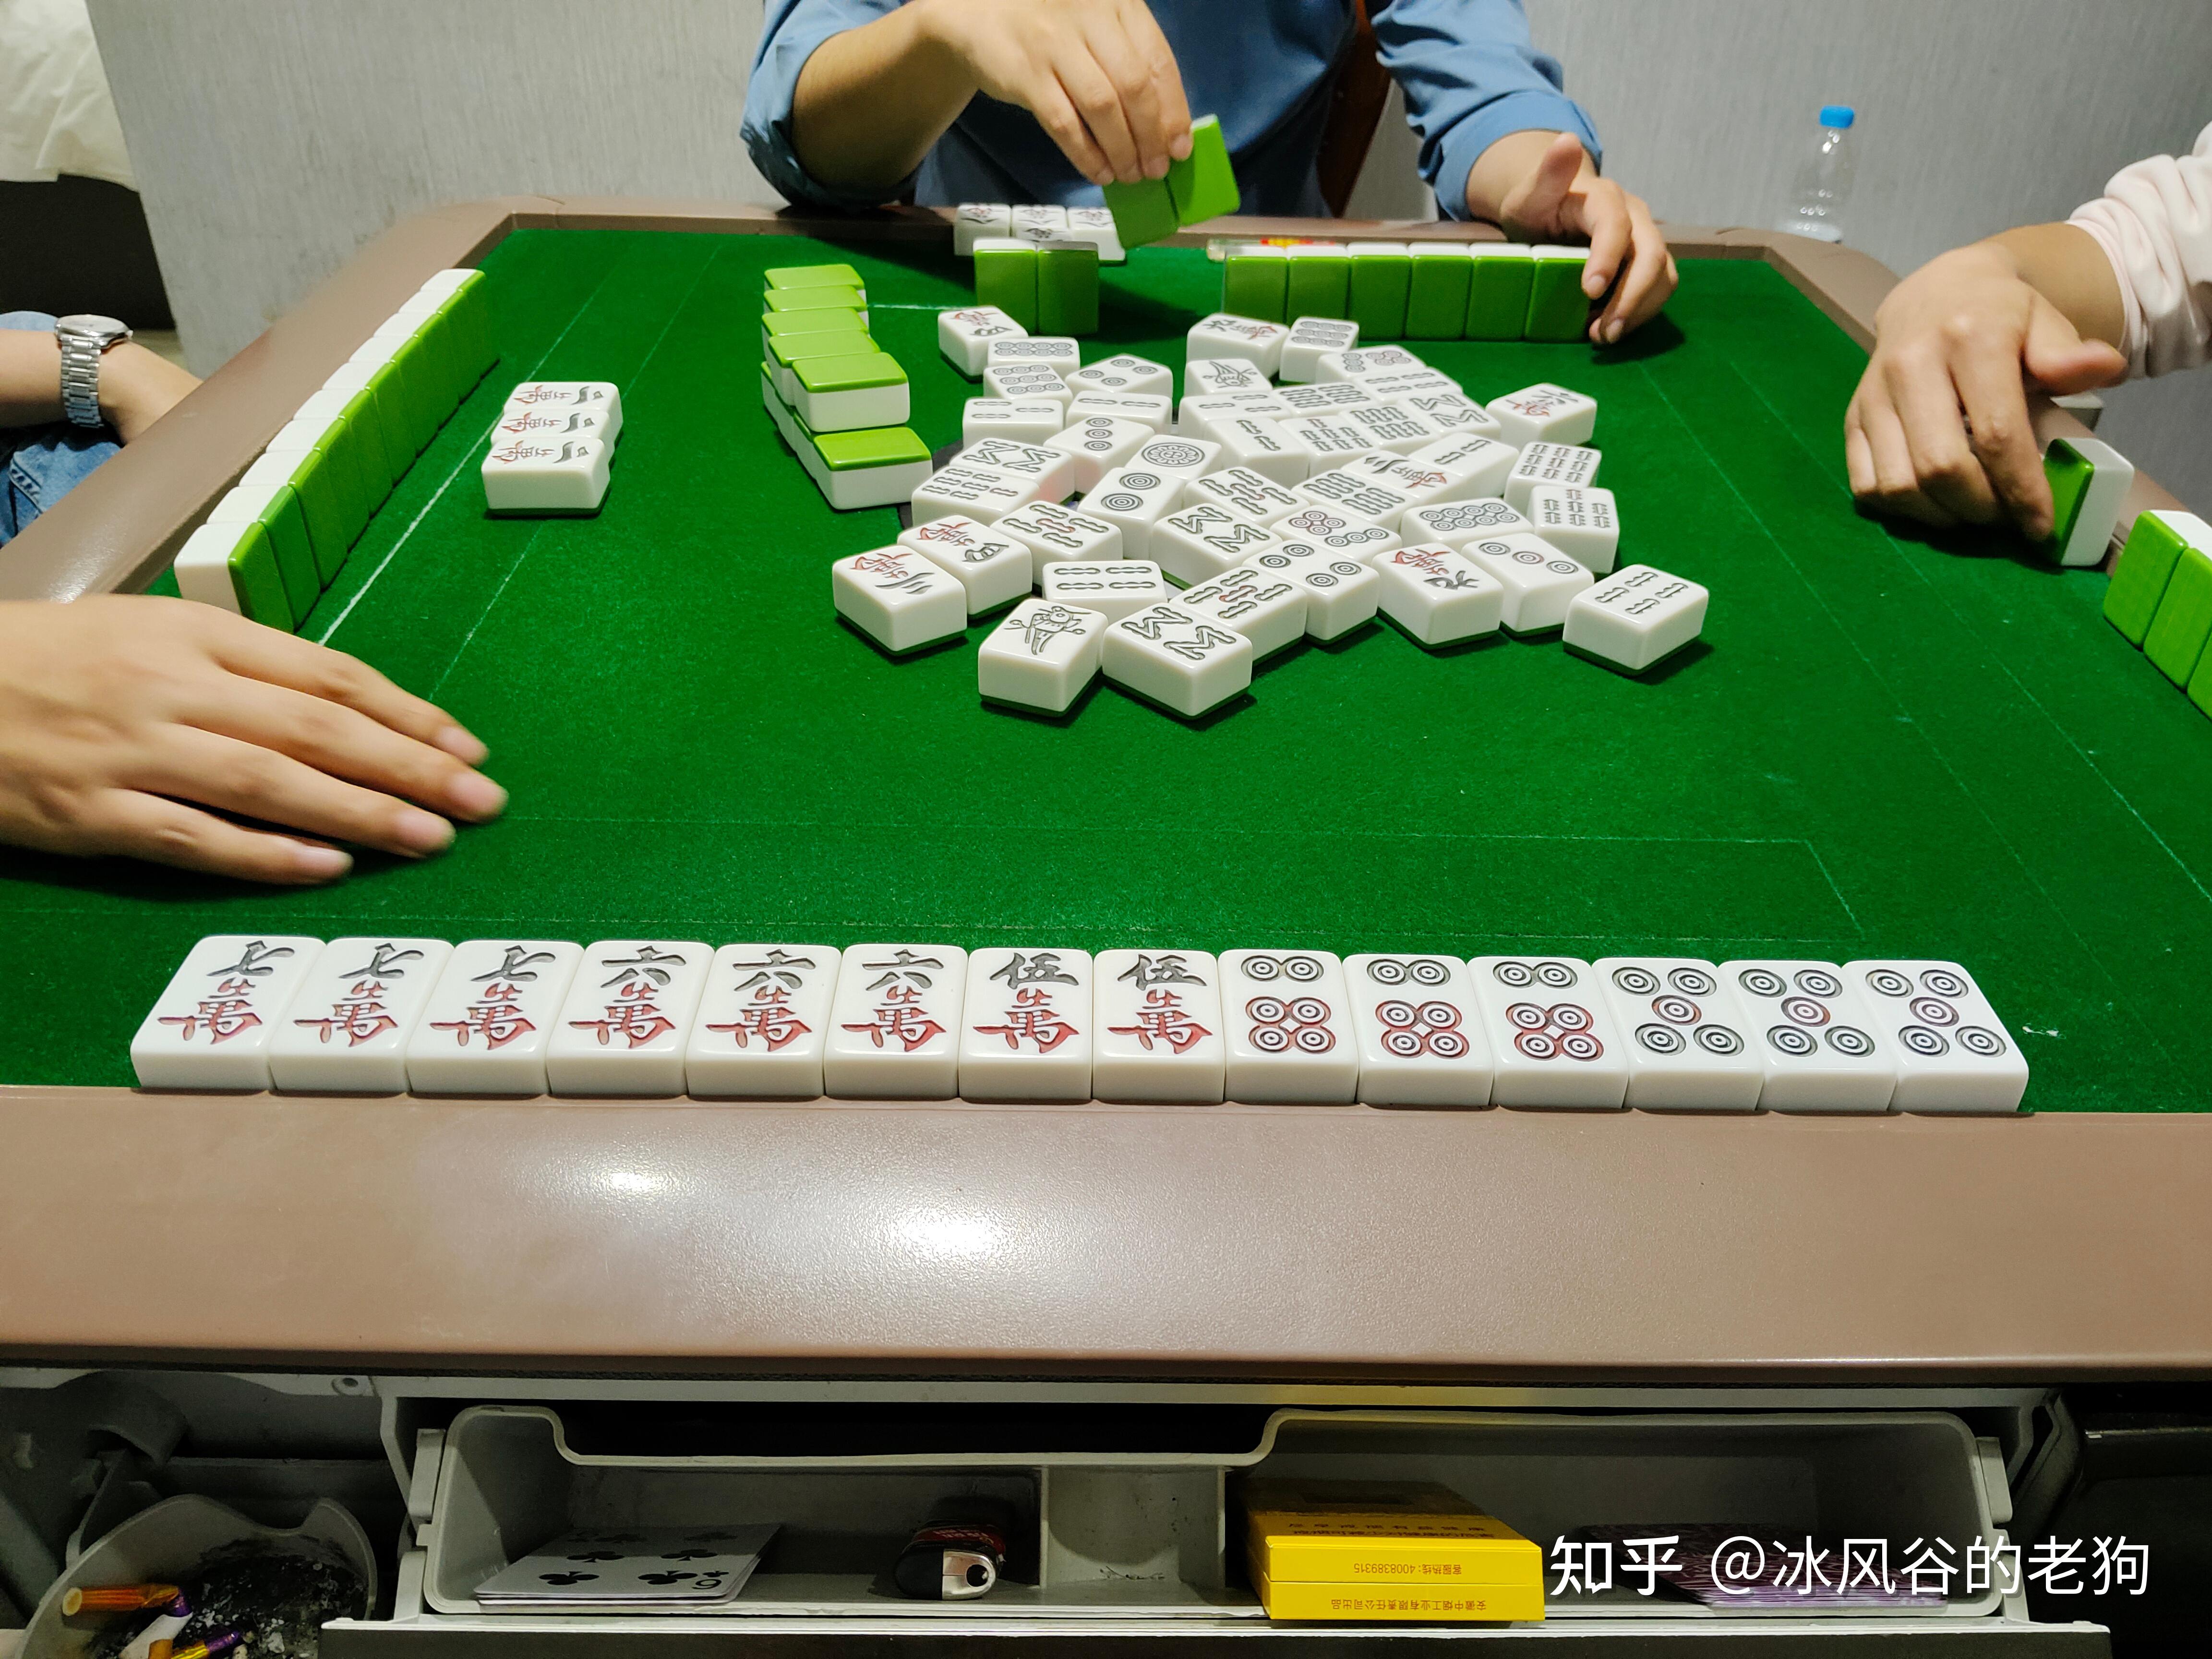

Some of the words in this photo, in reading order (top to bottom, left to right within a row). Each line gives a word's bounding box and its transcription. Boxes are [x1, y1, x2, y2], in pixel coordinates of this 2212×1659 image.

[849, 553, 935, 595] 三萬
[916, 522, 1009, 563] 四萬
[157, 940, 295, 1045] 七萬
[294, 942, 424, 1047] 七萬
[430, 945, 556, 1050] 七萬
[568, 945, 686, 1049] 六萬
[706, 949, 816, 1052] 六萬
[841, 949, 947, 1052] 六萬
[973, 952, 1080, 1054] 伍萬
[1107, 953, 1214, 1055] 伍萬
[1331, 1599, 1487, 1611] 安徽中烟工业有限责任公司出品
